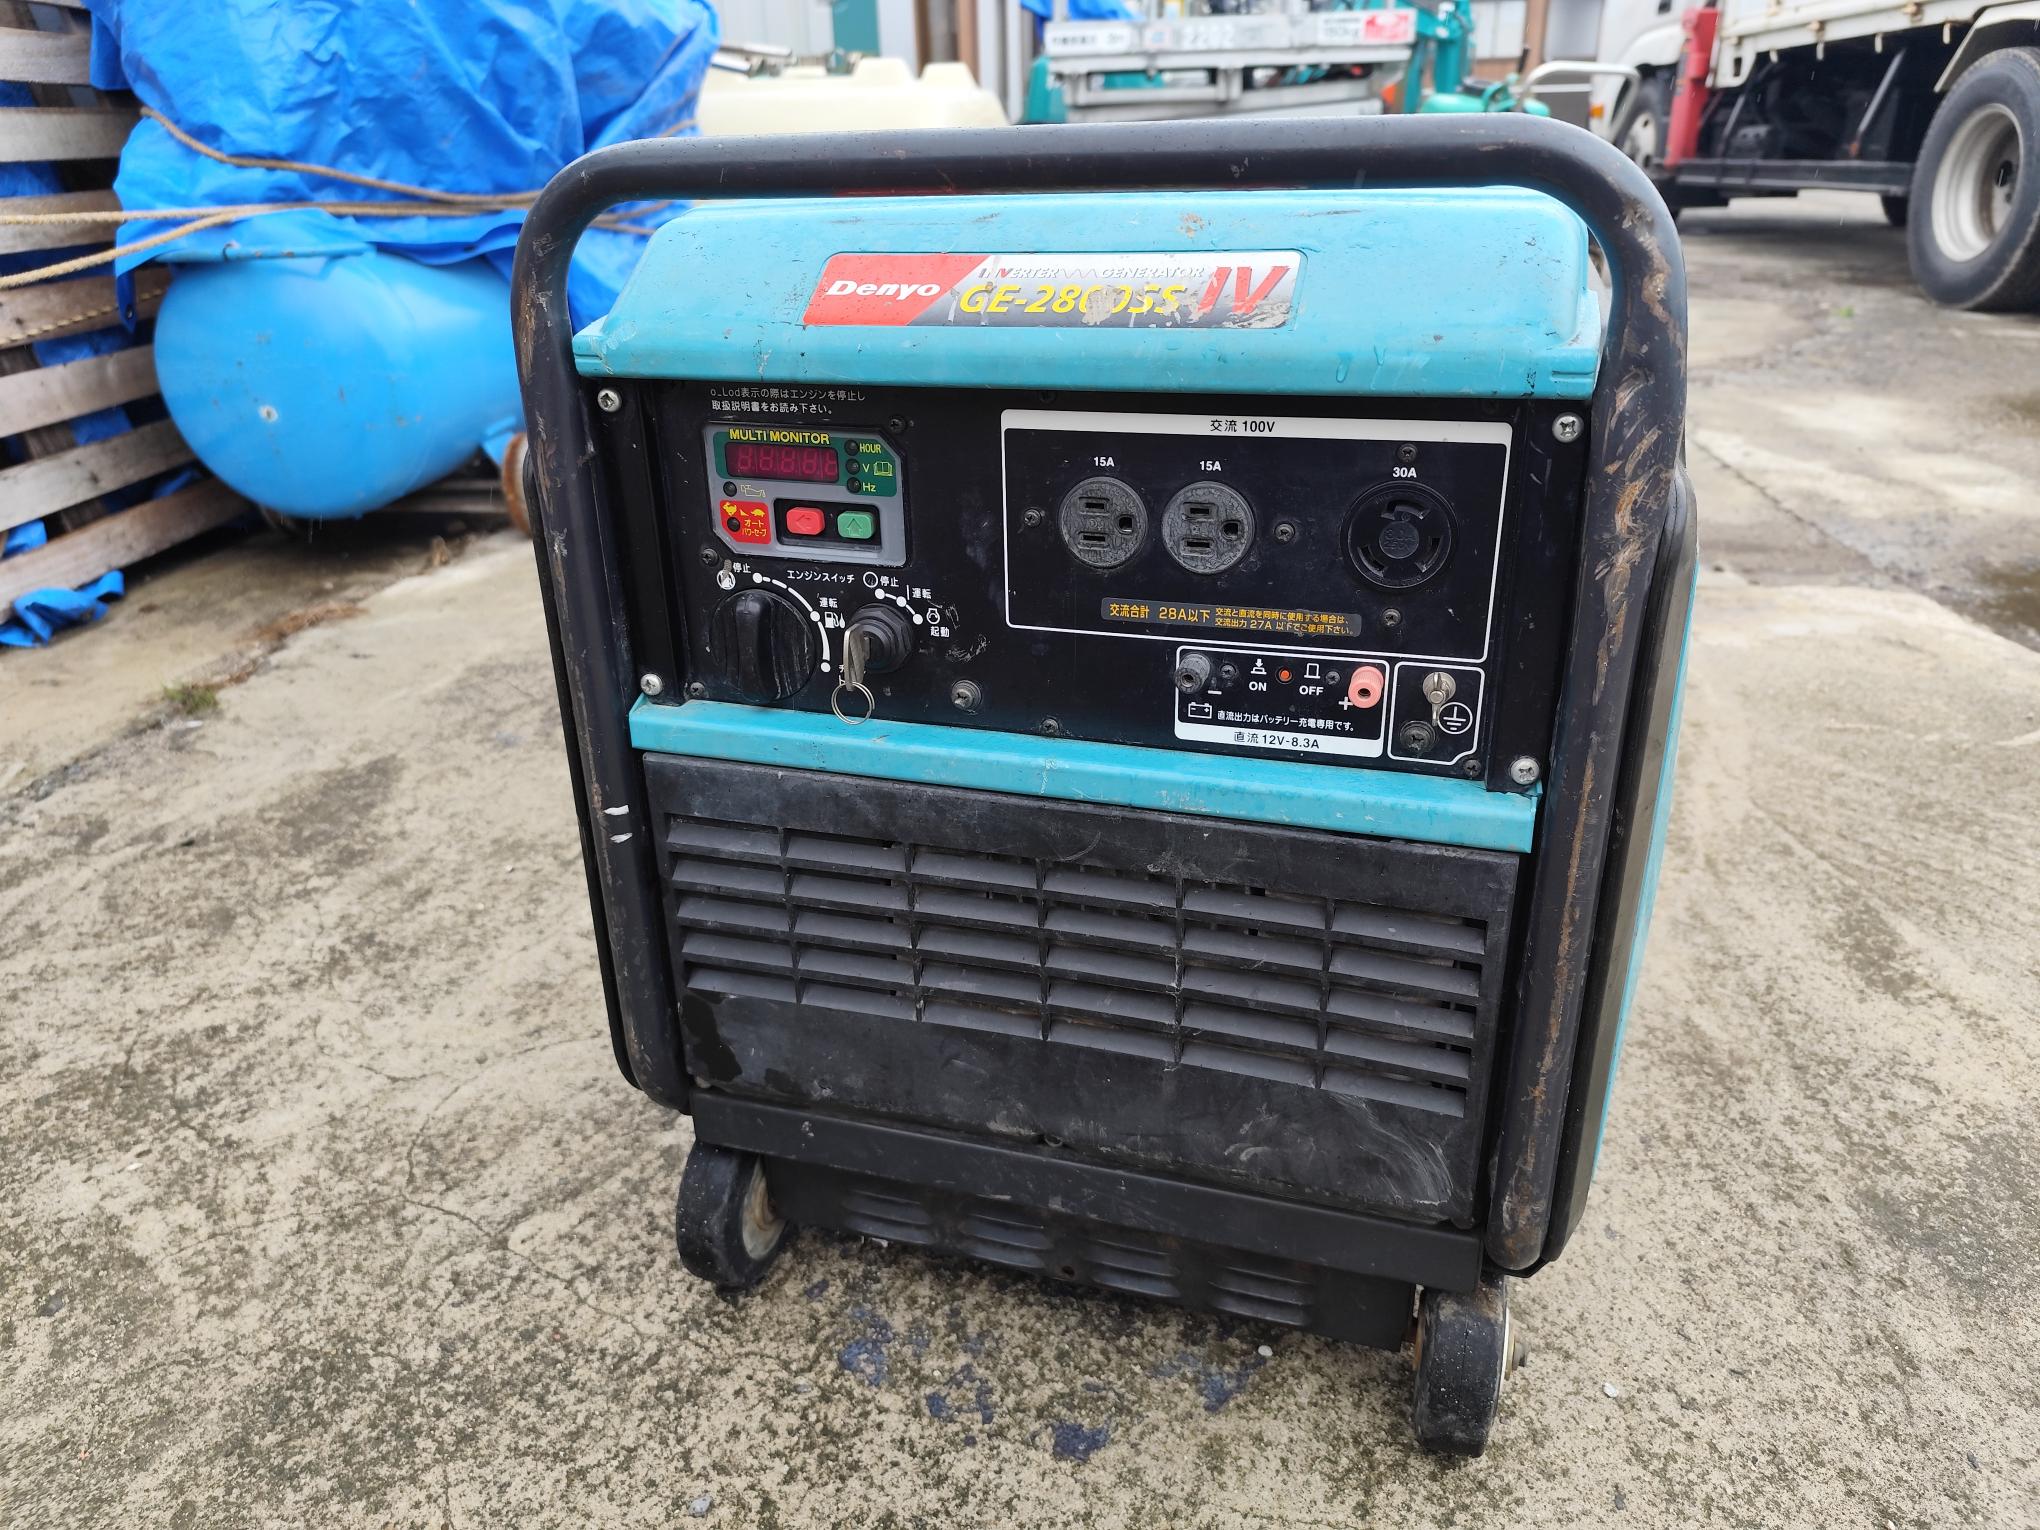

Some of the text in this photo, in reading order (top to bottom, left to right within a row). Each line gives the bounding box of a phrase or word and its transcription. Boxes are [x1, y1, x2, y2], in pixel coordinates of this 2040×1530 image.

[1102, 267, 1205, 279] GENERATOR
[825, 280, 941, 301] Denyo
[1197, 265, 1291, 315] IV
[711, 399, 833, 415] 取扱説明書をお読み下さい。
[1210, 419, 1275, 433] 交流 100V
[729, 428, 831, 445] MULTI MONITOR
[859, 443, 882, 454] HOUR
[862, 463, 870, 473] V
[1093, 457, 1115, 468] 15A
[1199, 460, 1222, 472] 15A
[1392, 467, 1418, 479] 30A
[862, 482, 876, 492] Hz
[744, 519, 765, 528] オート
[733, 562, 751, 573] 停止
[787, 570, 855, 584] エンジンスイッチ
[880, 576, 899, 588] 停止
[912, 587, 931, 599] 運転
[819, 597, 838, 609] 運転
[1109, 603, 1211, 623] 交流合計 28A以下
[1214, 618, 1247, 628] 交流出力
[1250, 619, 1272, 630] 27A
[930, 626, 950, 638] 起動
[1248, 681, 1267, 692] ON
[1299, 685, 1324, 696] OFF
[1217, 710, 1354, 732] 直流出力はバッテリー充電専用です。
[1233, 731, 1320, 749] 直流 12V-8.3A
